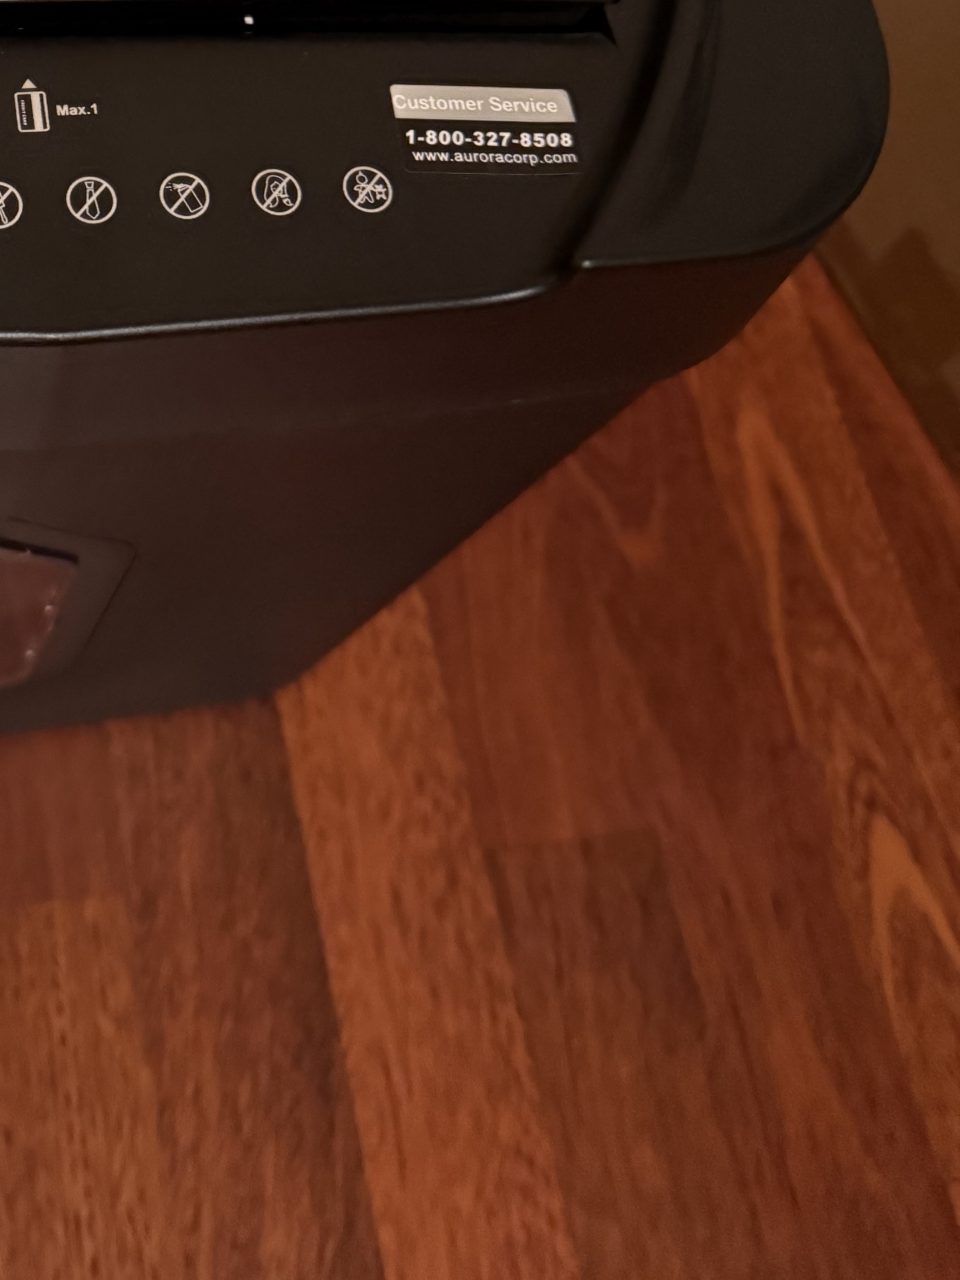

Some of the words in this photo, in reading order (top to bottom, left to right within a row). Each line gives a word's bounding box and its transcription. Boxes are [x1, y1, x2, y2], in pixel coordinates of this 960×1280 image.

[393, 94, 484, 111] Customer
[489, 97, 558, 113] Service
[405, 129, 573, 147] 1-800-327-8508
[412, 150, 578, 166] www.auroracorp.com
